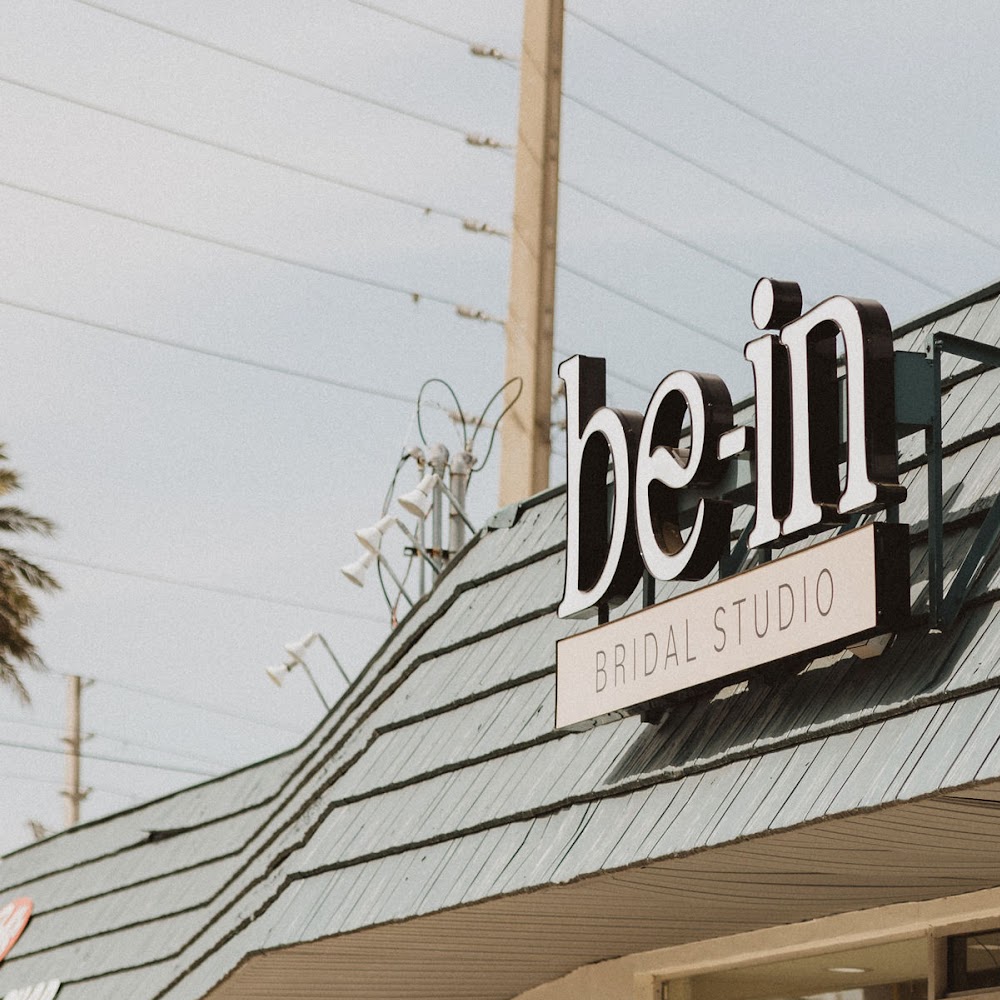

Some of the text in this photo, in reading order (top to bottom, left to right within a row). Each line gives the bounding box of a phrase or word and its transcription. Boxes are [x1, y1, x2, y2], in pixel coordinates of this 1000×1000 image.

[557, 277, 880, 619] be-in
[595, 567, 835, 693] BRIDAL STUDIO
